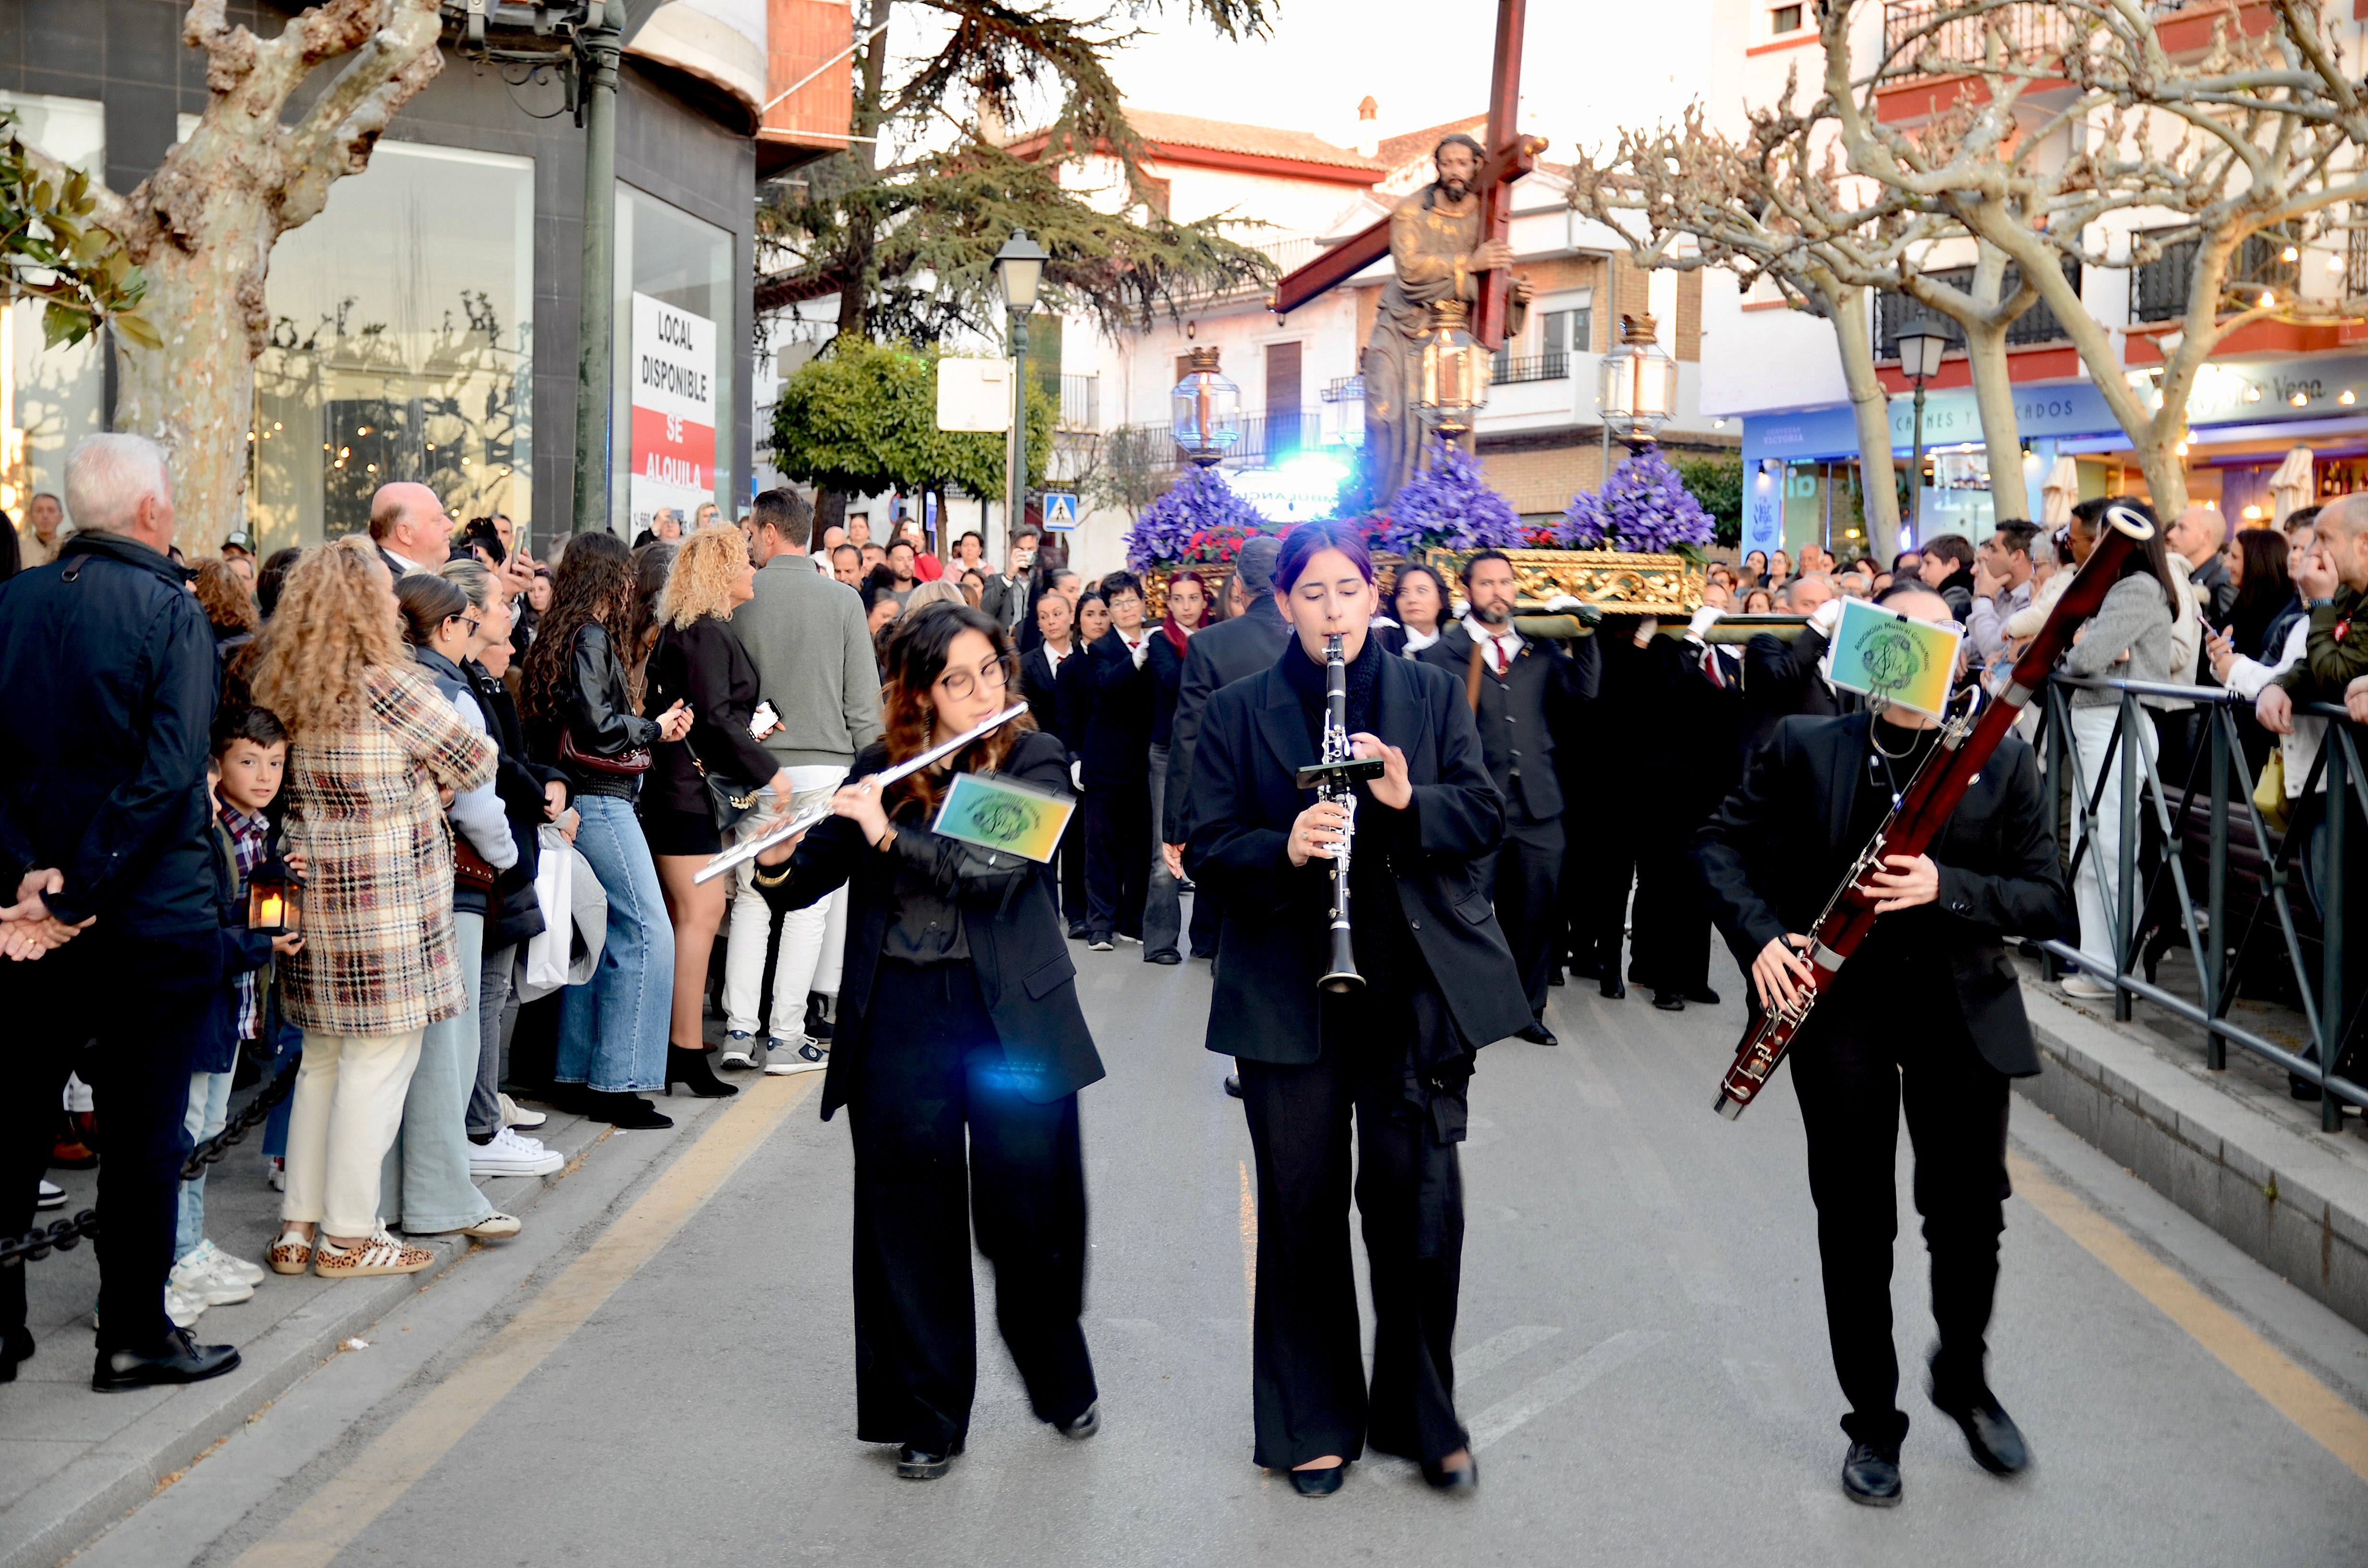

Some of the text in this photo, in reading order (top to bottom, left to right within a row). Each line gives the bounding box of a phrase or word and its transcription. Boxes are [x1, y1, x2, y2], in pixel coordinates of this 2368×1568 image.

[659, 310, 692, 351] LOCAL
[643, 355, 706, 402] DISPONIBLE
[666, 411, 683, 444] SE
[1897, 411, 1953, 431] CANES
[2015, 400, 2072, 420] CADOS
[1764, 433, 1804, 444] VICTORIA
[646, 452, 702, 492] ALQUILA
[1885, 622, 1912, 634] Musical
